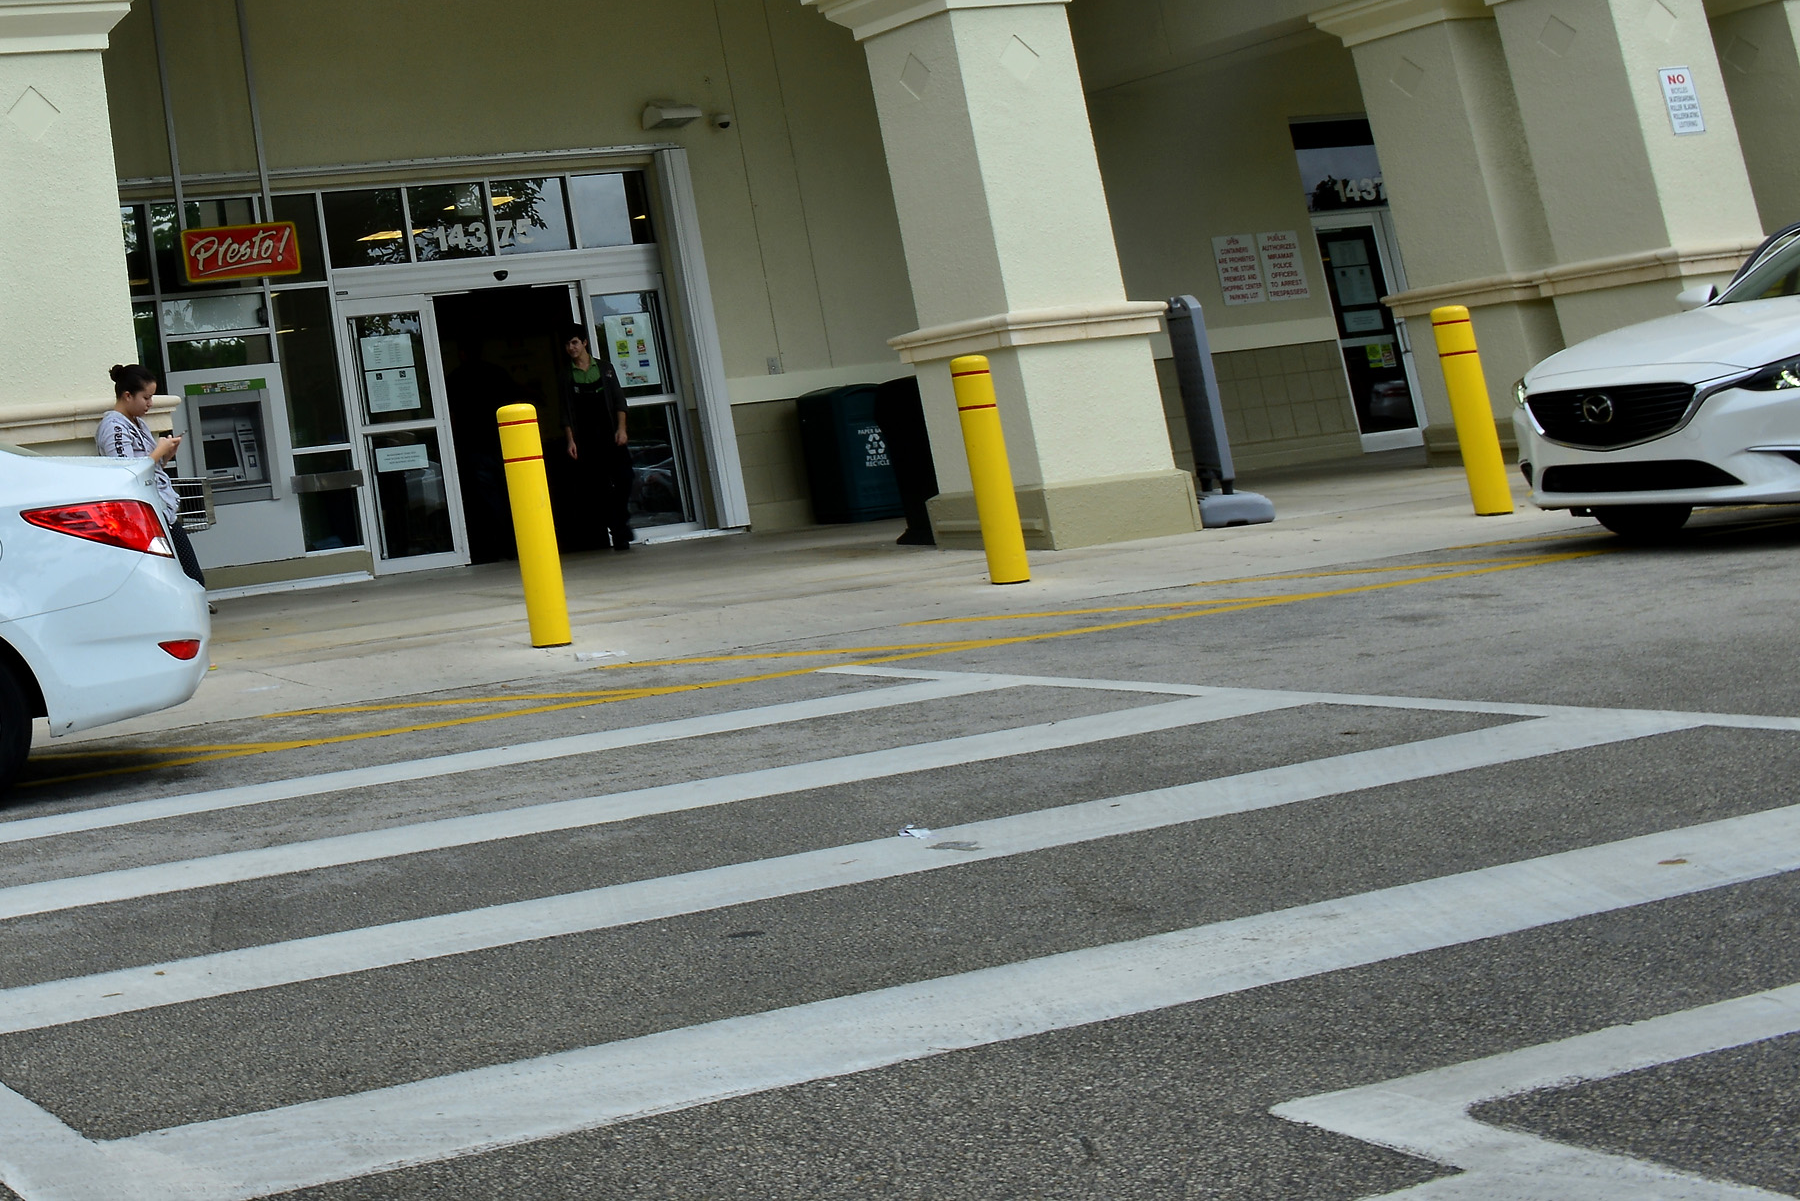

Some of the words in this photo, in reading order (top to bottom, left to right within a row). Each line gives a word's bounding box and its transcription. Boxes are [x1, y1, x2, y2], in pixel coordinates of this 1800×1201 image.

[1667, 74, 1685, 84] NO
[190, 227, 290, 271] Presto!
[1262, 243, 1296, 251] AUTHORIZES
[1268, 252, 1294, 260] MIRAMAR
[1271, 270, 1298, 278] OFFICERS
[1281, 279, 1302, 287] ARREST
[1269, 288, 1307, 297] TRESPASSERS
